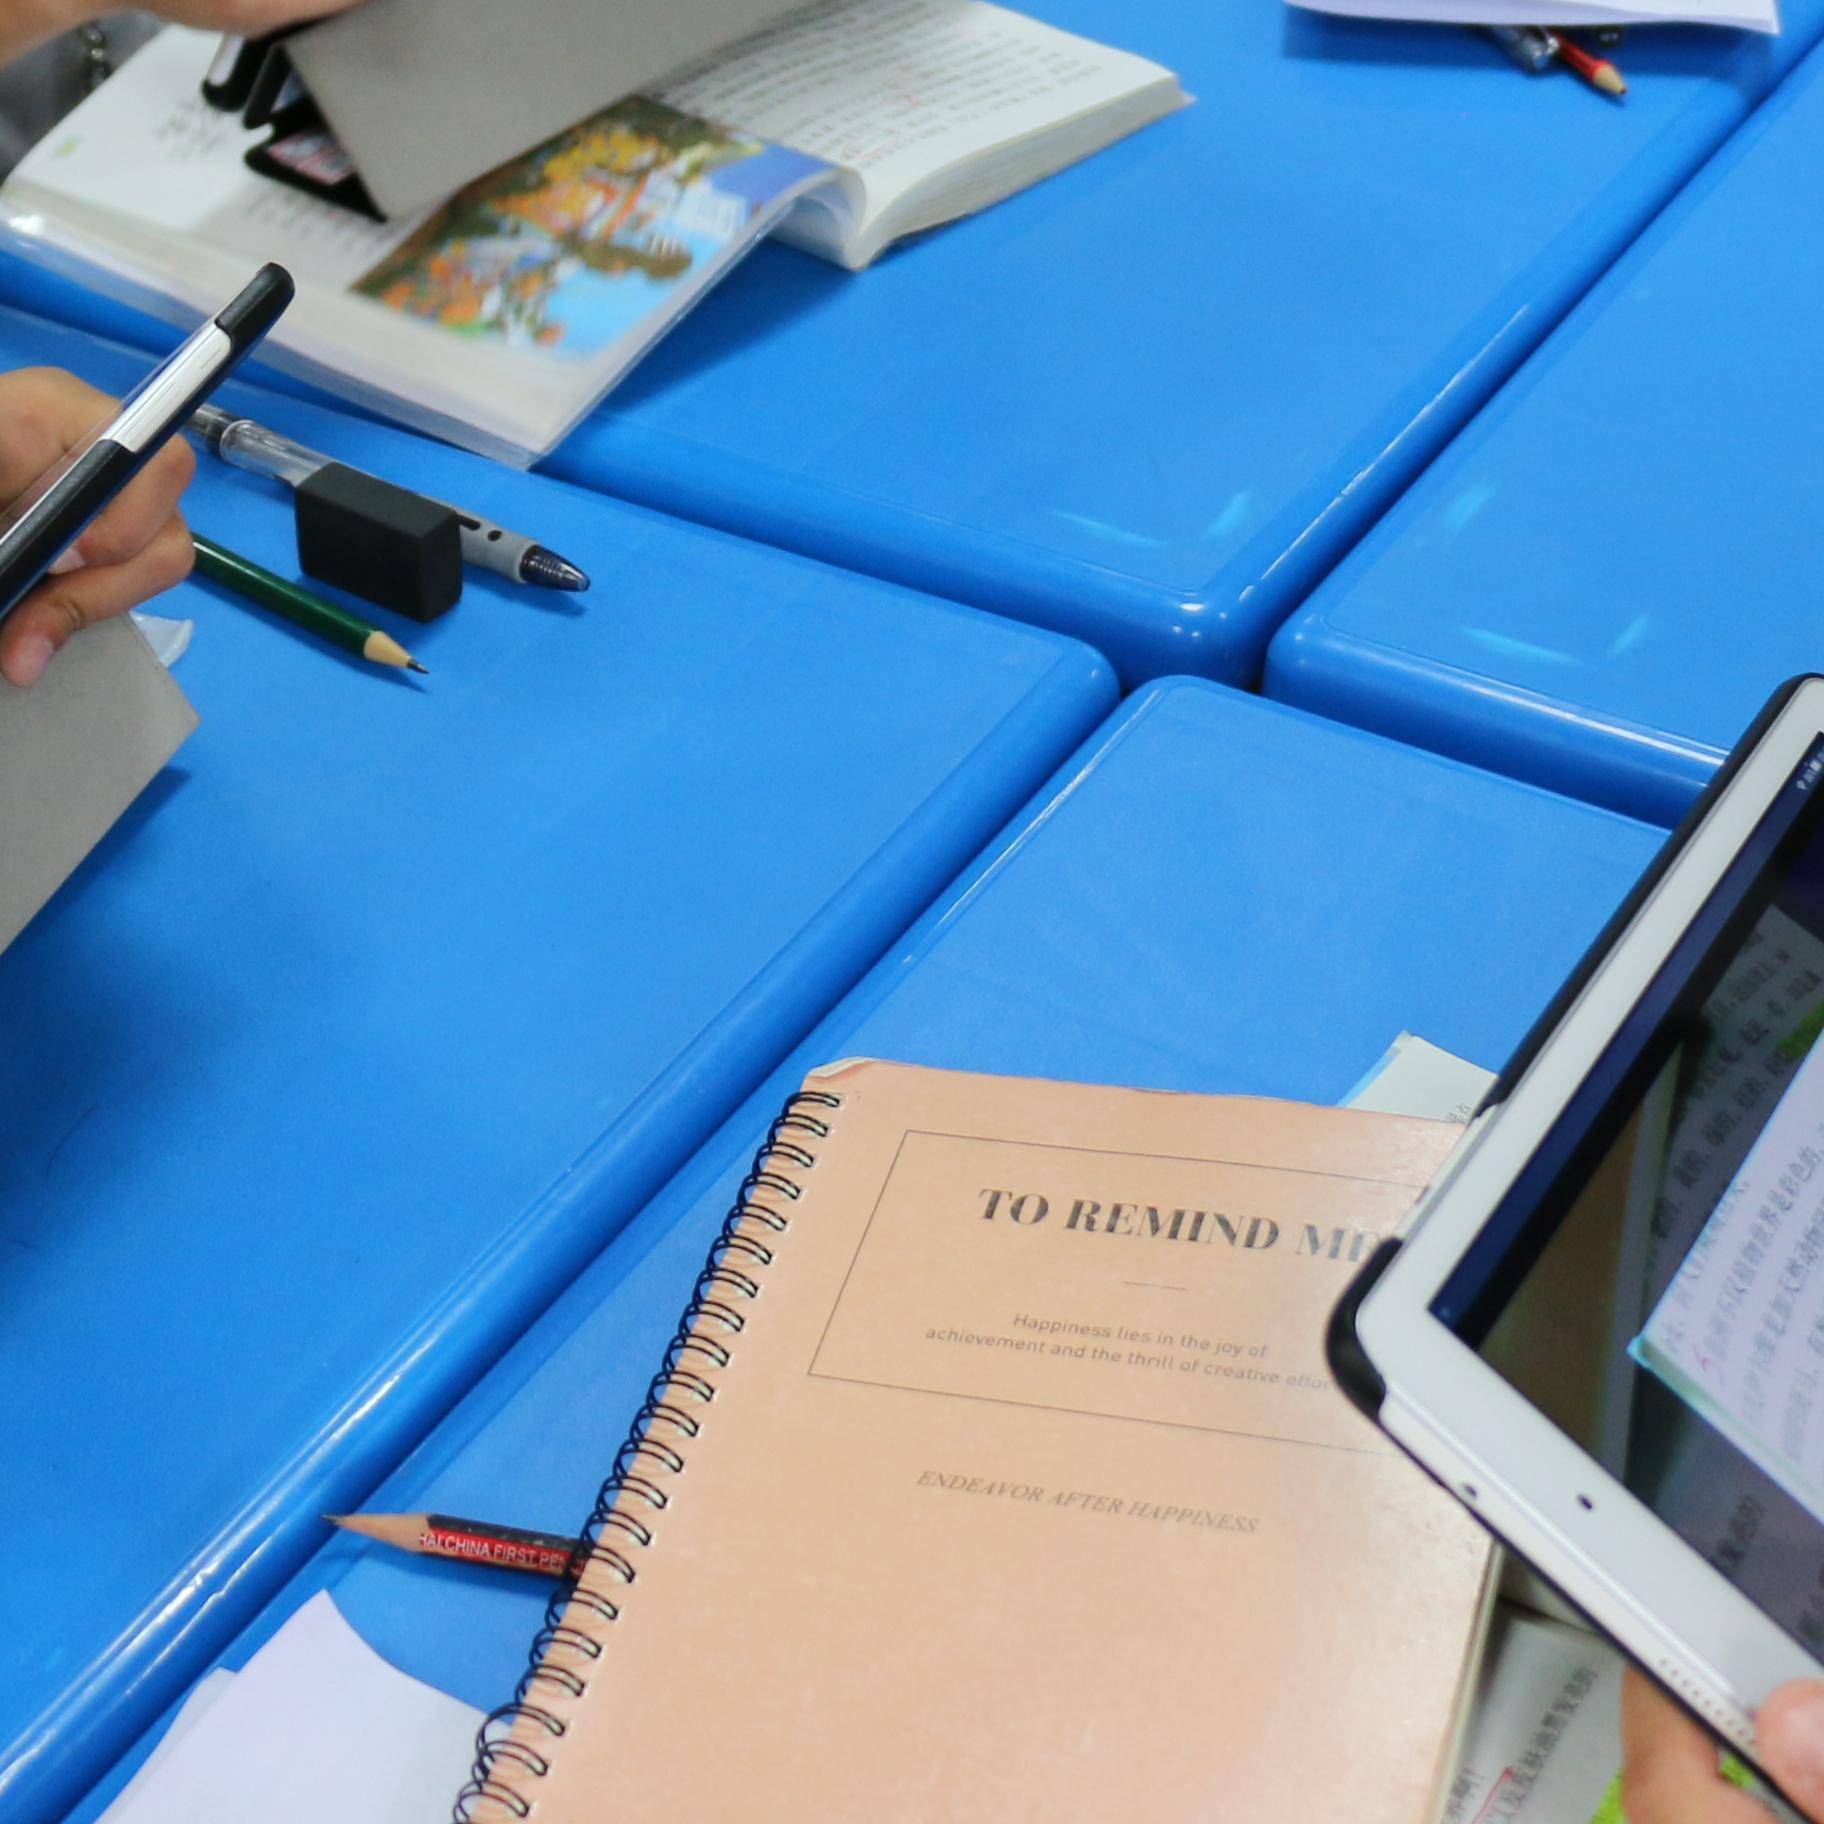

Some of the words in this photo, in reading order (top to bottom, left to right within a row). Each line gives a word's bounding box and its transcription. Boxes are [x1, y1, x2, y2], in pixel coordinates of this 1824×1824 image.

[978, 1188, 1049, 1225] TO
[1064, 1199, 1280, 1252] REMIND
[925, 1325, 1045, 1355] achievement
[1050, 1342, 1086, 1359] and
[1091, 1345, 1121, 1363] the
[1127, 1351, 1175, 1372] thrill
[1180, 1357, 1200, 1373] of
[1204, 1360, 1280, 1385] creative
[1286, 1373, 1333, 1390] effor
[1013, 1312, 1111, 1339] Happiness
[1117, 1324, 1151, 1343] lies
[1157, 1331, 1174, 1345] in
[1180, 1335, 1209, 1351] the
[1215, 1339, 1244, 1357] joy
[1248, 1343, 1269, 1357] of
[916, 1470, 1045, 1503] ENDEAVOR
[1048, 1489, 1124, 1515] AFTER
[1128, 1501, 1260, 1533] HAPPINESS
[445, 1535, 491, 1556] CHINA
[494, 1545, 537, 1563] FIRST
